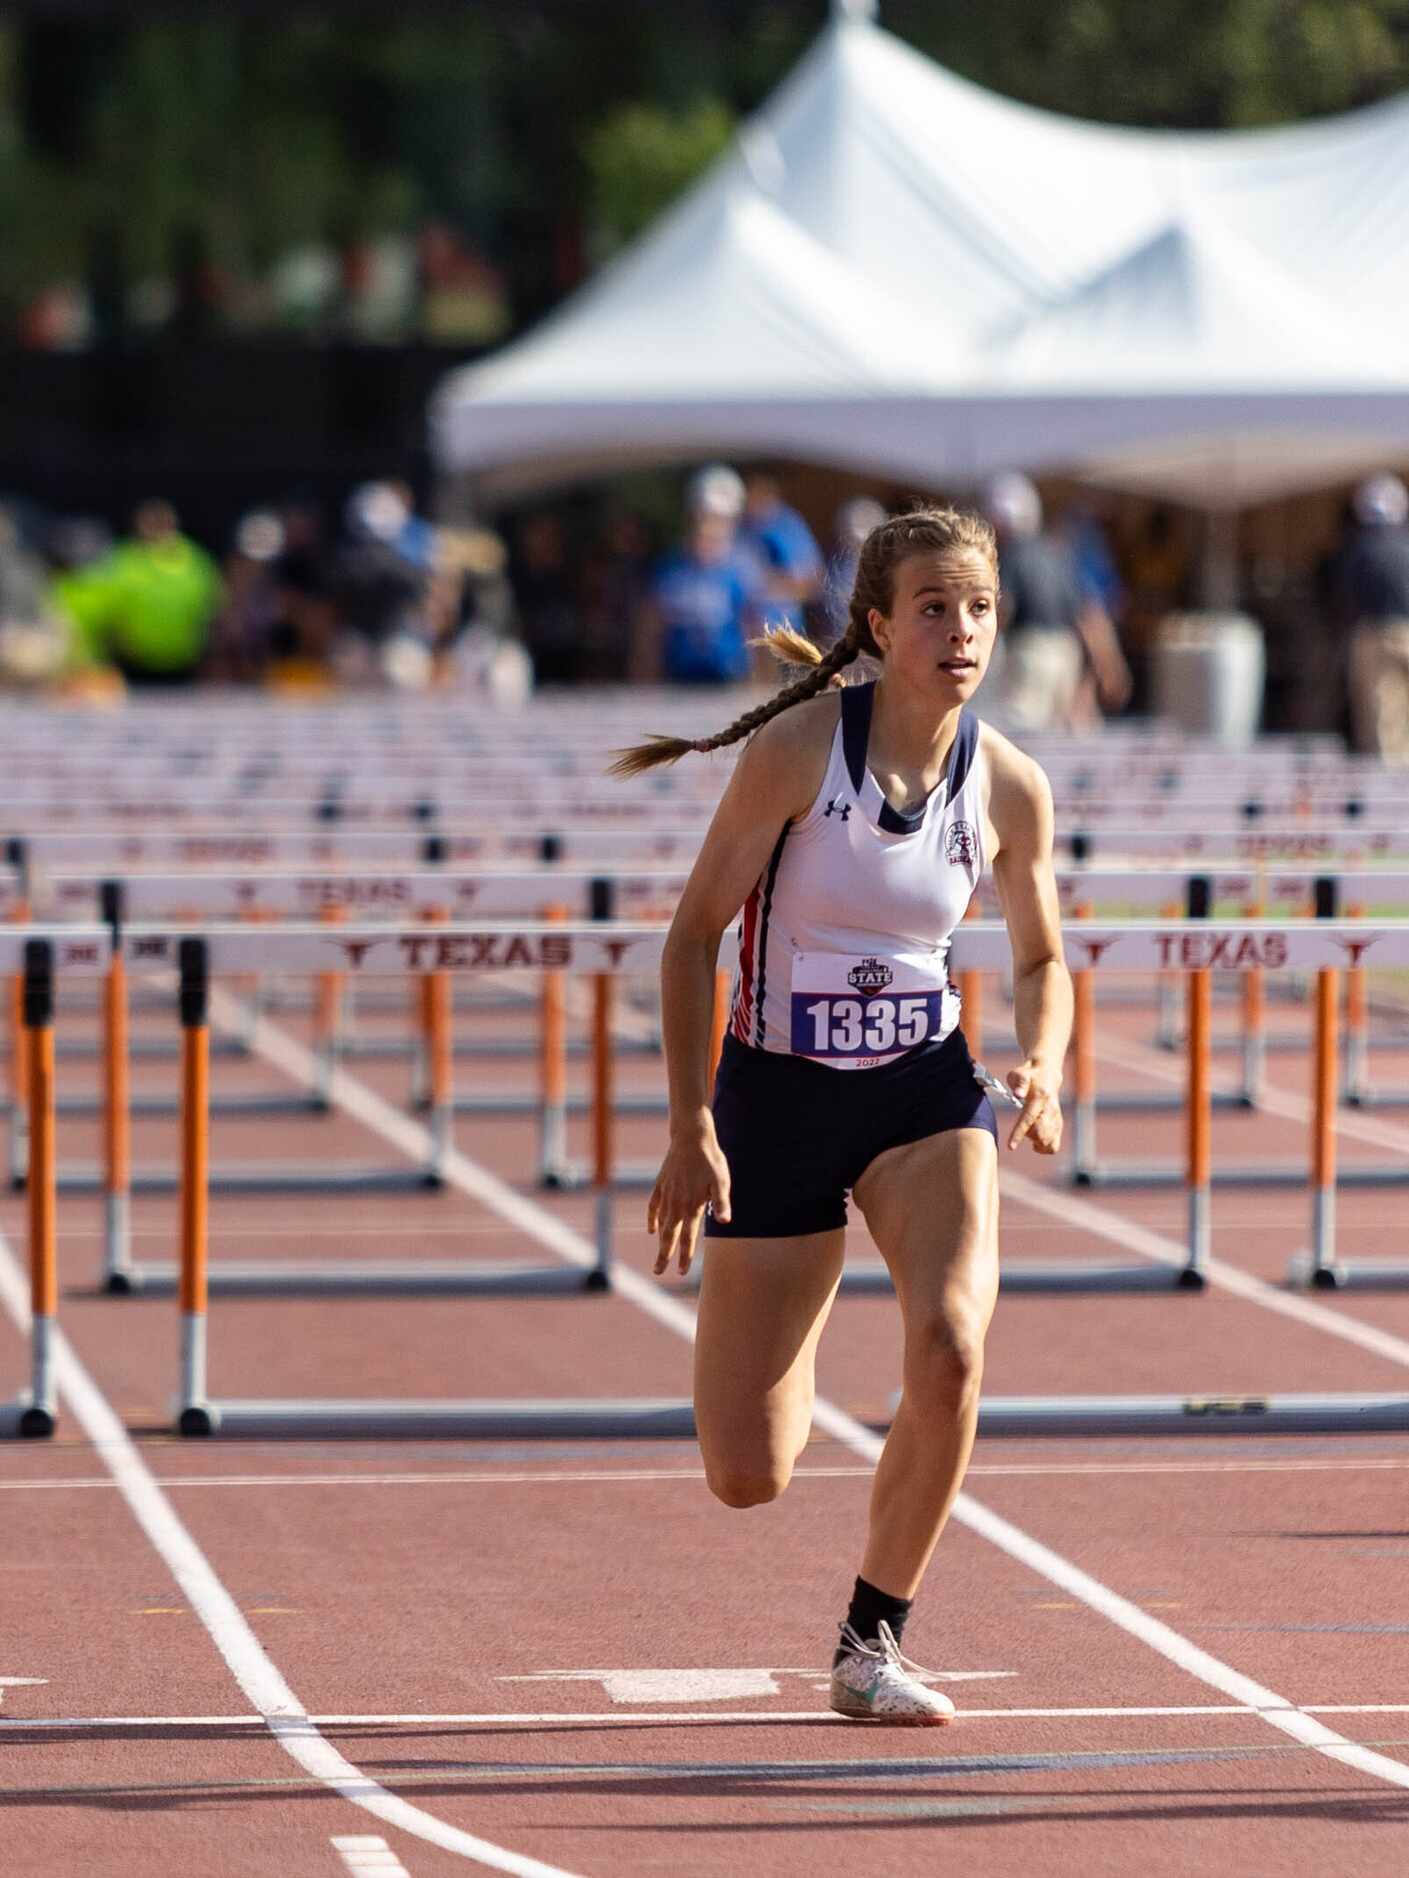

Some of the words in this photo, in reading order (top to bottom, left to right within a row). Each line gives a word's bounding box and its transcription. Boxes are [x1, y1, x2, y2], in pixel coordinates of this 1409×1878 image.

[400, 933, 572, 969] TEXAS
[1152, 932, 1289, 969] TEXAS
[848, 972, 892, 985] STATE
[806, 998, 929, 1051] 1335
